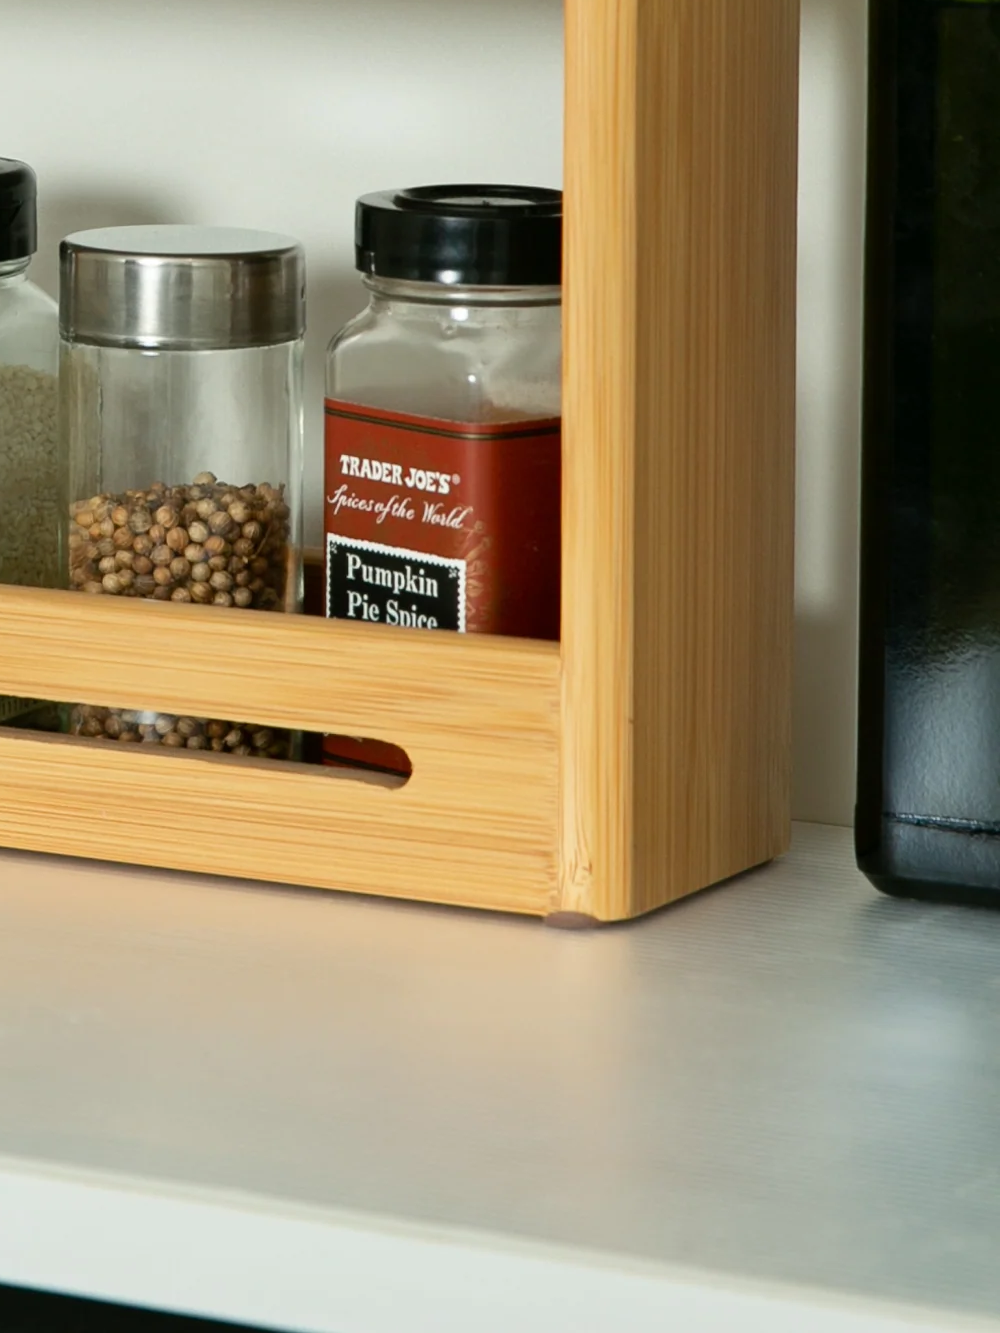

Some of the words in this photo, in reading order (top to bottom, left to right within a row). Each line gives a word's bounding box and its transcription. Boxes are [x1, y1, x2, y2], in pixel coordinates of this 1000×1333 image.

[340, 454, 403, 485] TRADER
[327, 484, 374, 515] Spices
[374, 495, 399, 524] of
[391, 497, 415, 520] the
[421, 500, 473, 529] World
[346, 552, 438, 598] Pumpkin
[346, 590, 380, 621] Pie
[386, 599, 438, 629] Spice
